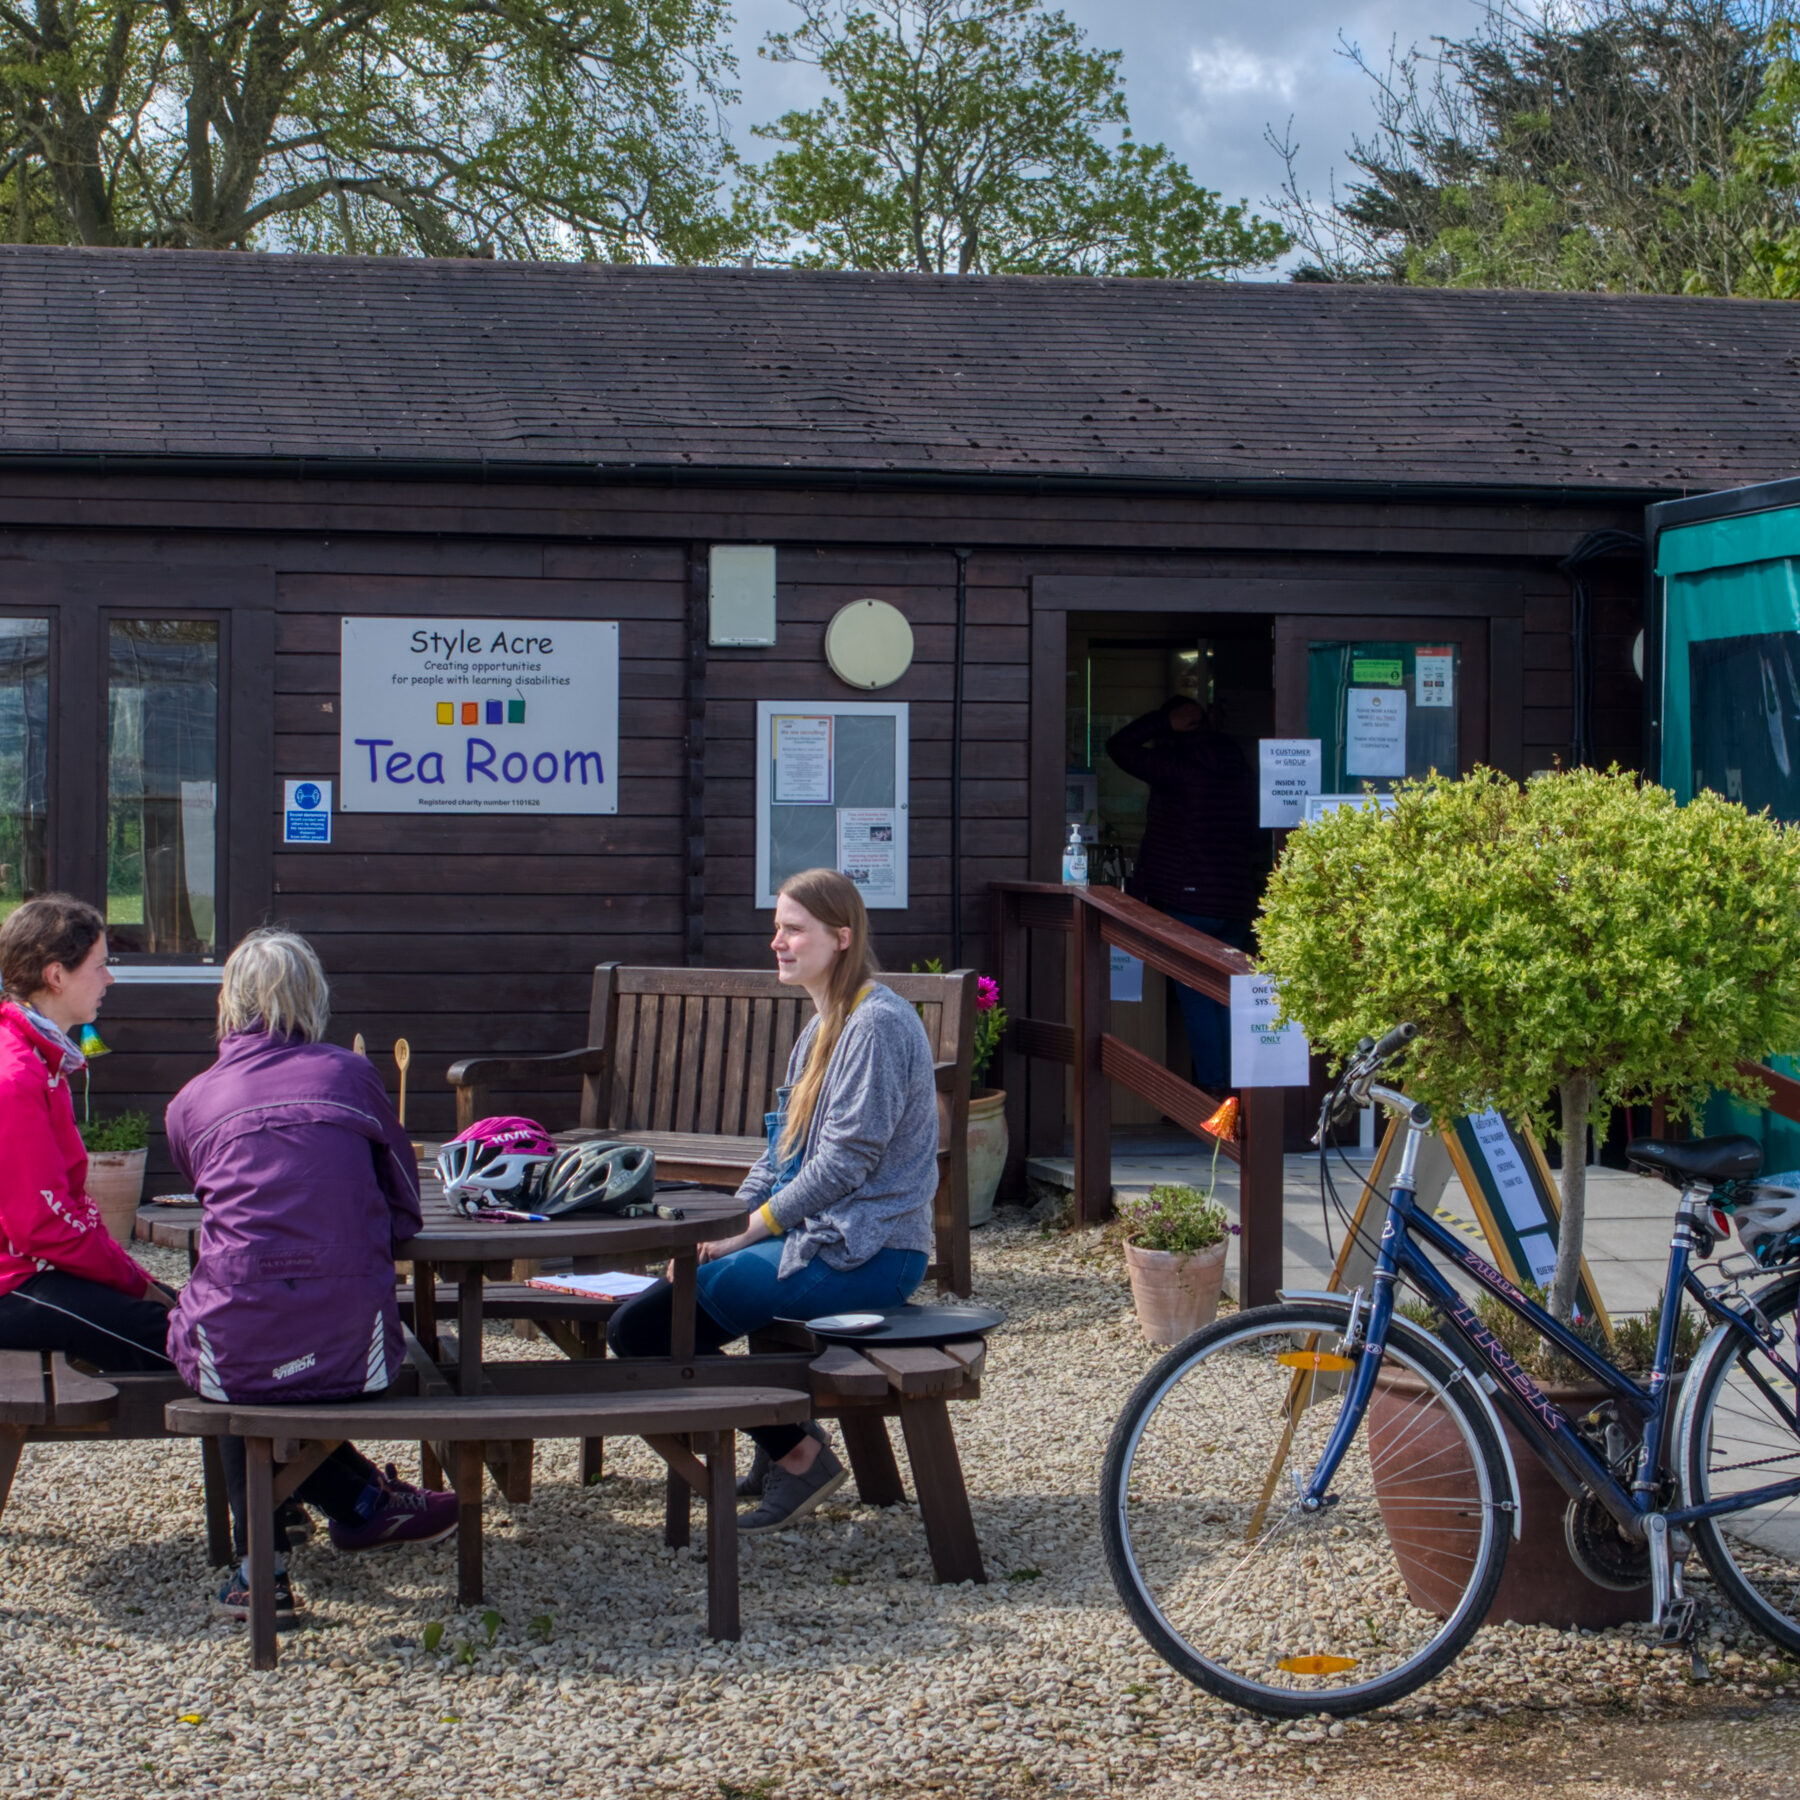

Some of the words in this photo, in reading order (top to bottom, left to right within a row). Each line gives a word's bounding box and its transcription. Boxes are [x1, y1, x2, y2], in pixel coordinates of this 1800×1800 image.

[410, 629, 482, 660] Style
[490, 632, 554, 654] Acre
[424, 660, 469, 673] Creating
[472, 662, 541, 673] opportunities
[392, 675, 408, 685] for
[411, 675, 444, 686] people
[447, 675, 469, 685] with
[472, 675, 512, 687] learning
[515, 676, 570, 686] disabilities
[354, 738, 445, 784] Tea
[466, 738, 604, 785] Room
[418, 798, 456, 807] Registered
[458, 799, 481, 807] charity
[492, 1130, 530, 1144] KASK
[276, 1357, 316, 1380] VISION
[1453, 1298, 1566, 1429] TREK
